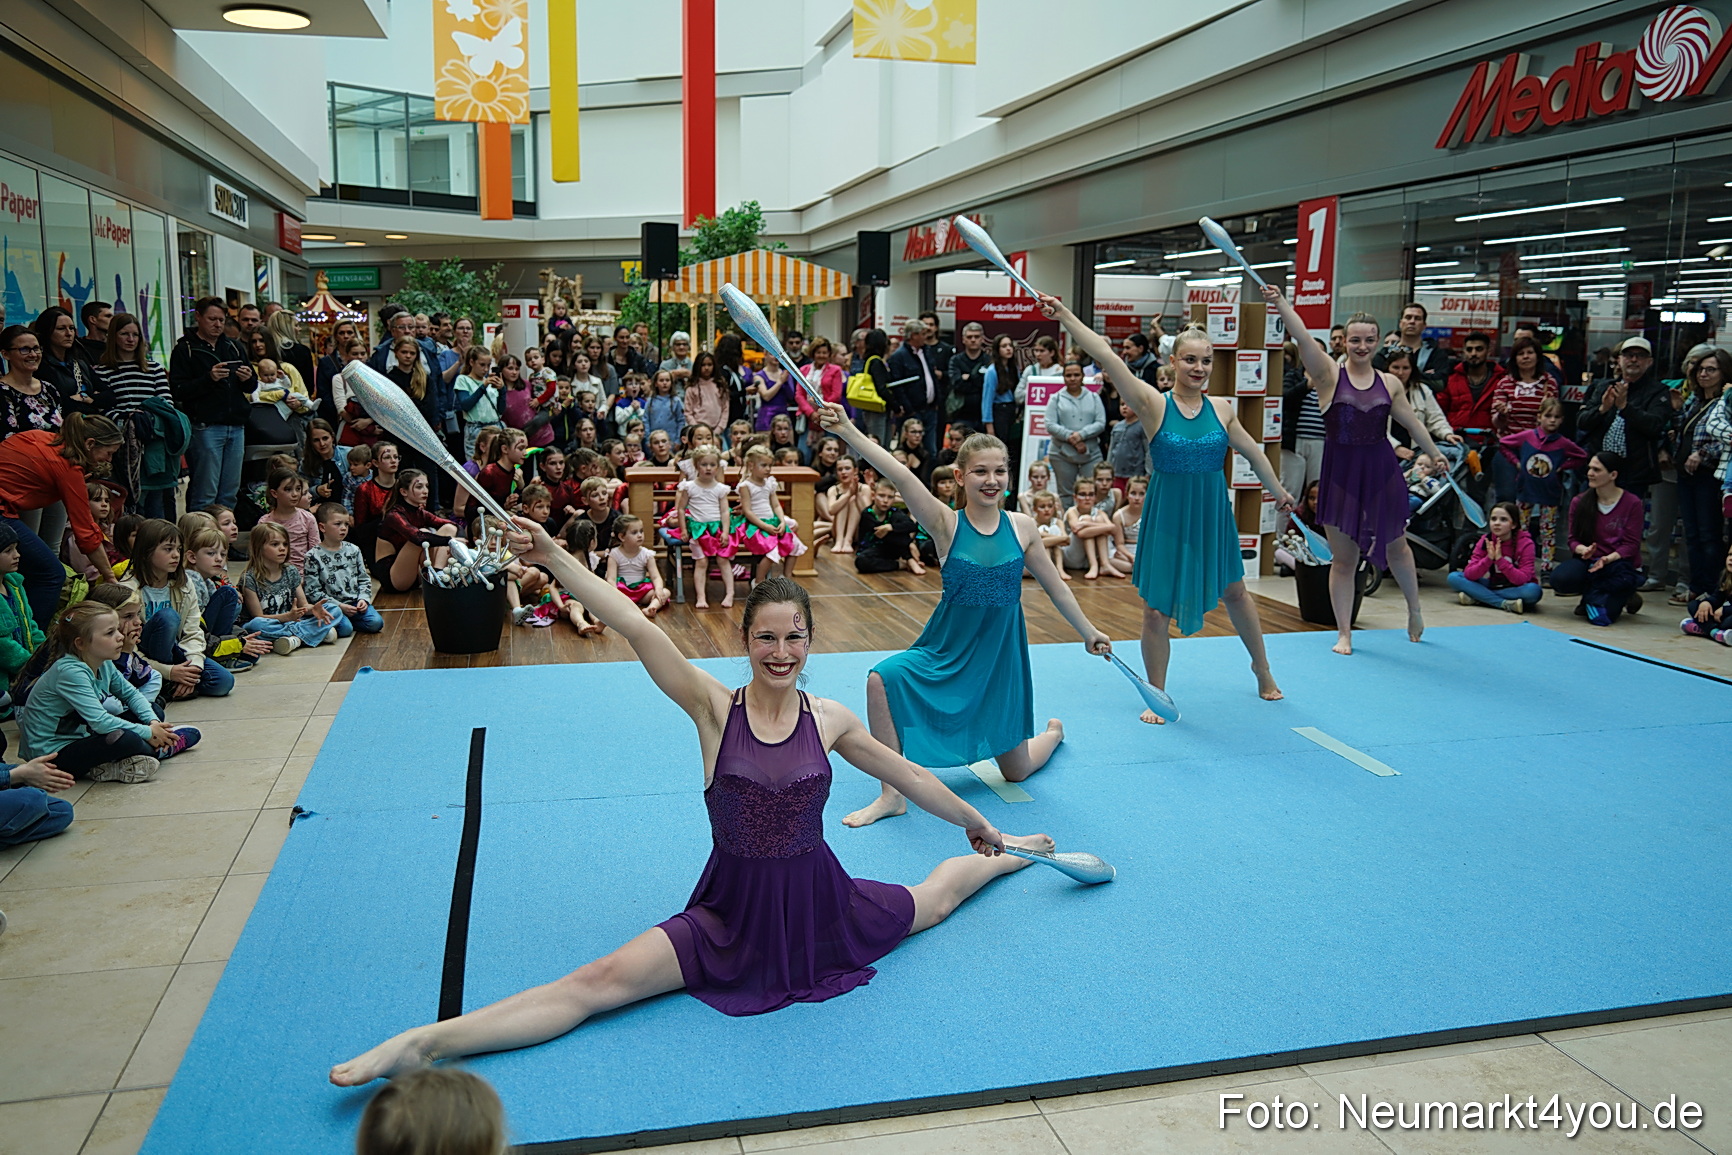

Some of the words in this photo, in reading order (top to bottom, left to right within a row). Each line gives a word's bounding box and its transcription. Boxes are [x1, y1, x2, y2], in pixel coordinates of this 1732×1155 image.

[94, 214, 131, 248] McPaper
[1307, 207, 1328, 273] 1
[1186, 289, 1229, 303] MUSIK
[1094, 302, 1135, 312] enkideen
[1440, 297, 1501, 312] SOFTWARE
